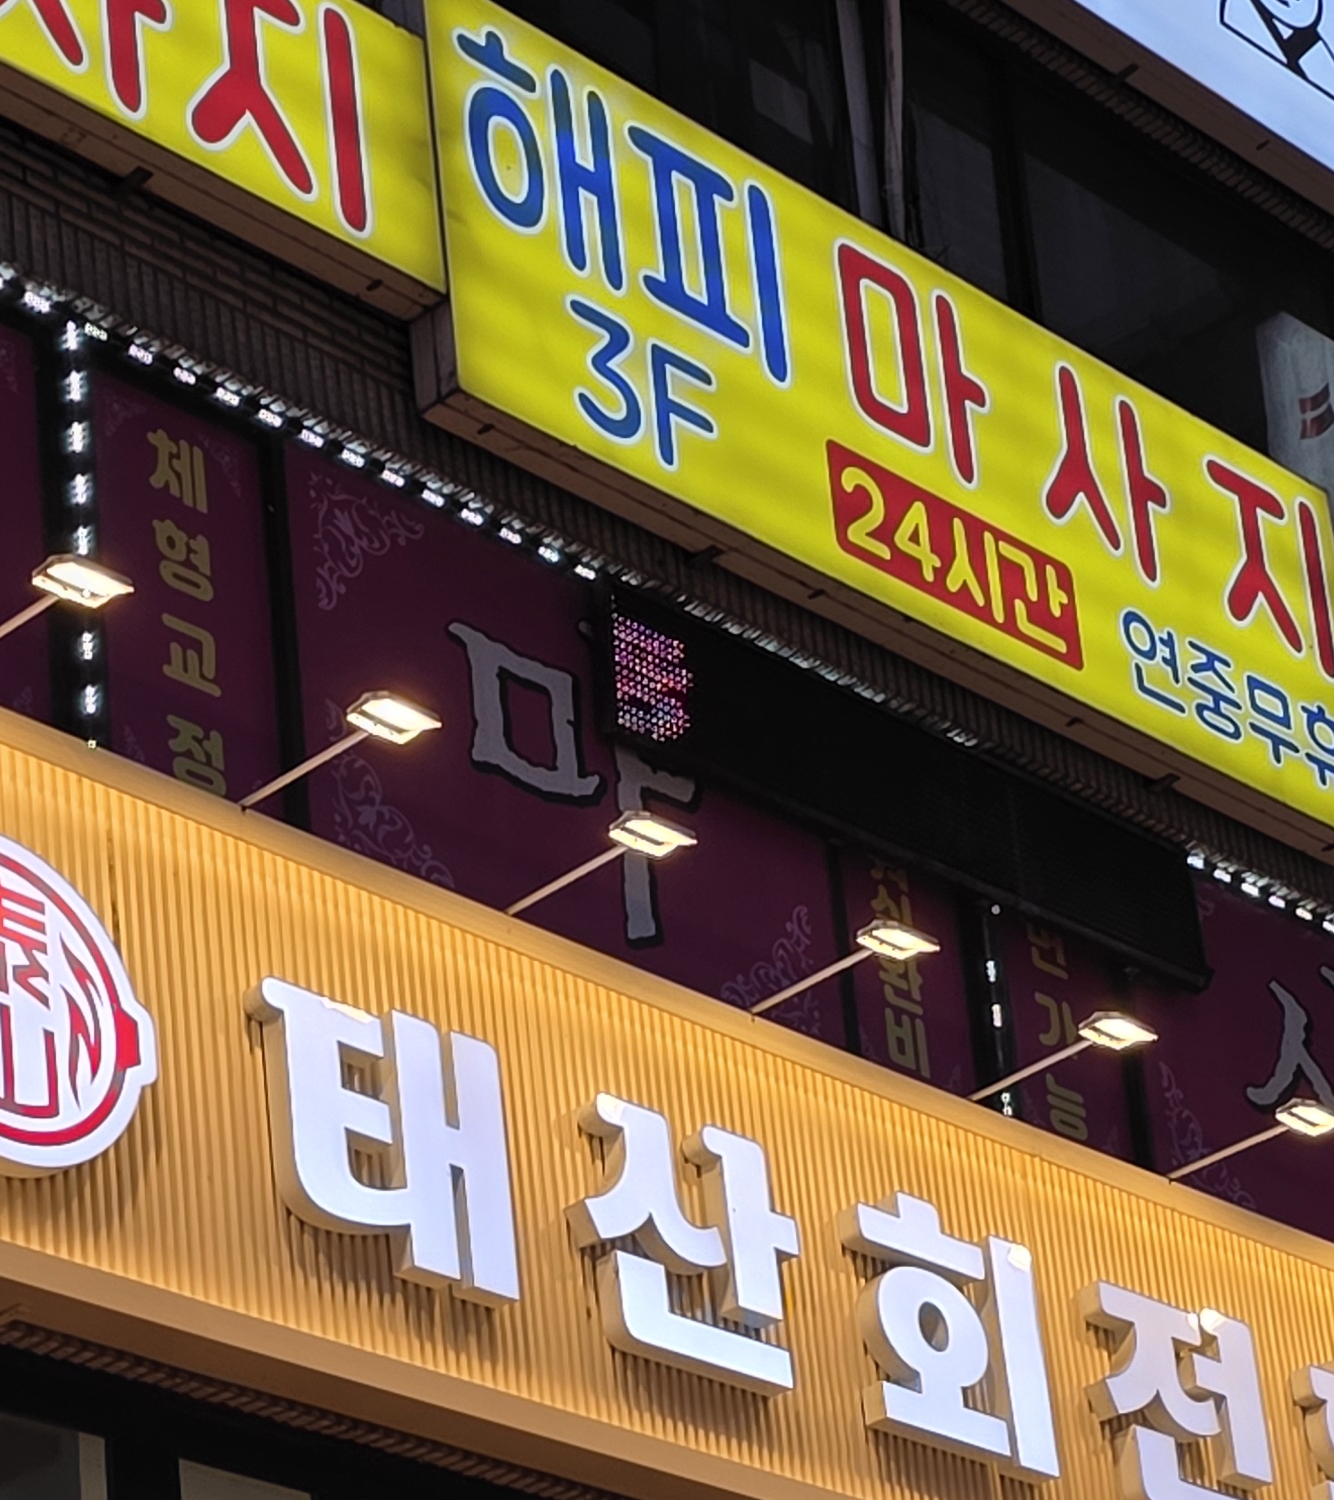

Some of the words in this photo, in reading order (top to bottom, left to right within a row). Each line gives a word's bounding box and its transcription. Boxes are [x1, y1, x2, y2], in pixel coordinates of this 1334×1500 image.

[457, 28, 790, 385] 해피
[568, 295, 715, 468] 3F
[837, 467, 1070, 654] 24시간
